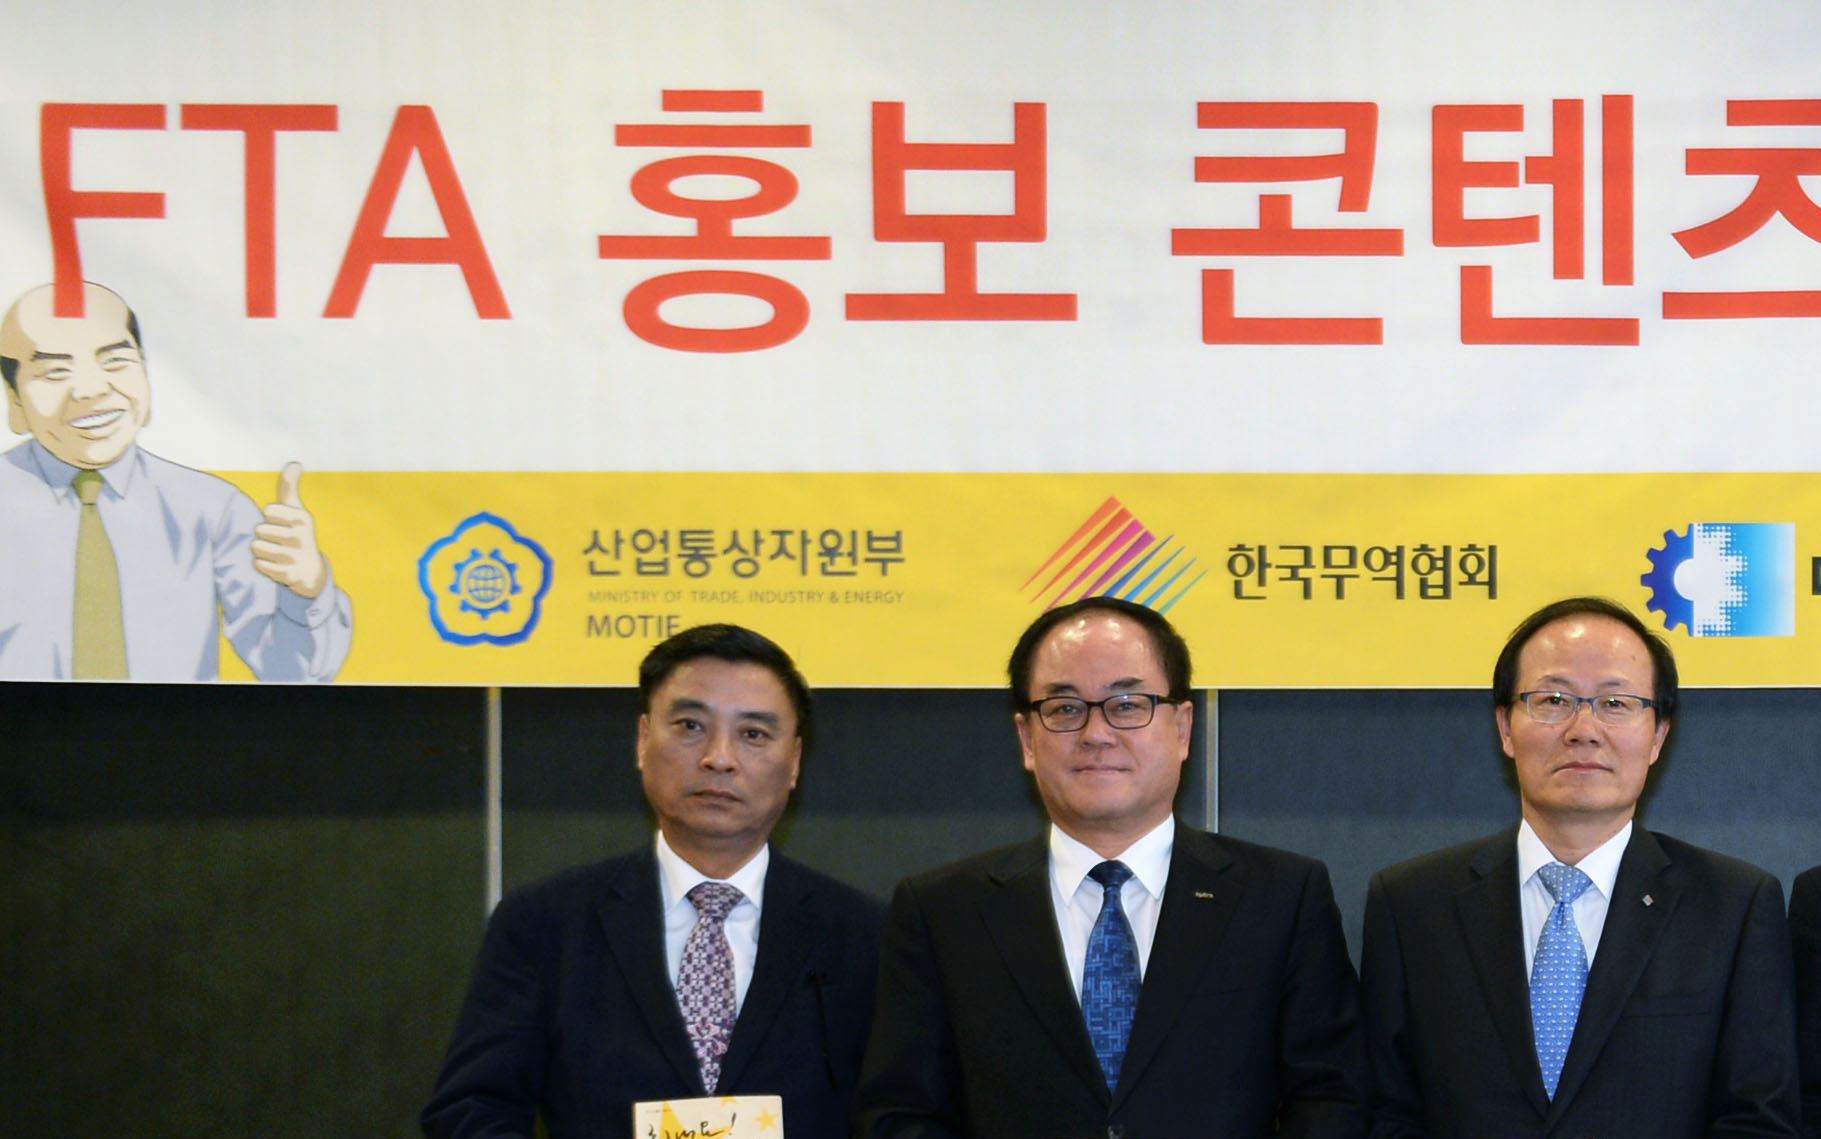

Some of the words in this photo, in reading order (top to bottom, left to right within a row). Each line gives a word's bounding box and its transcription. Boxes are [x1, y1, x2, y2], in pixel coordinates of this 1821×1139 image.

[41, 103, 511, 318] FTA
[598, 89, 1078, 353] 홍보
[583, 528, 905, 578] 산업통상자원부
[1226, 543, 1498, 600] 한국무역협회
[588, 590, 658, 603] MINISTRY
[664, 590, 682, 603] OF
[750, 590, 824, 604] INDUSTRY
[829, 591, 840, 604] &
[844, 590, 904, 604] ENERGY
[587, 614, 681, 638] MOTIE
